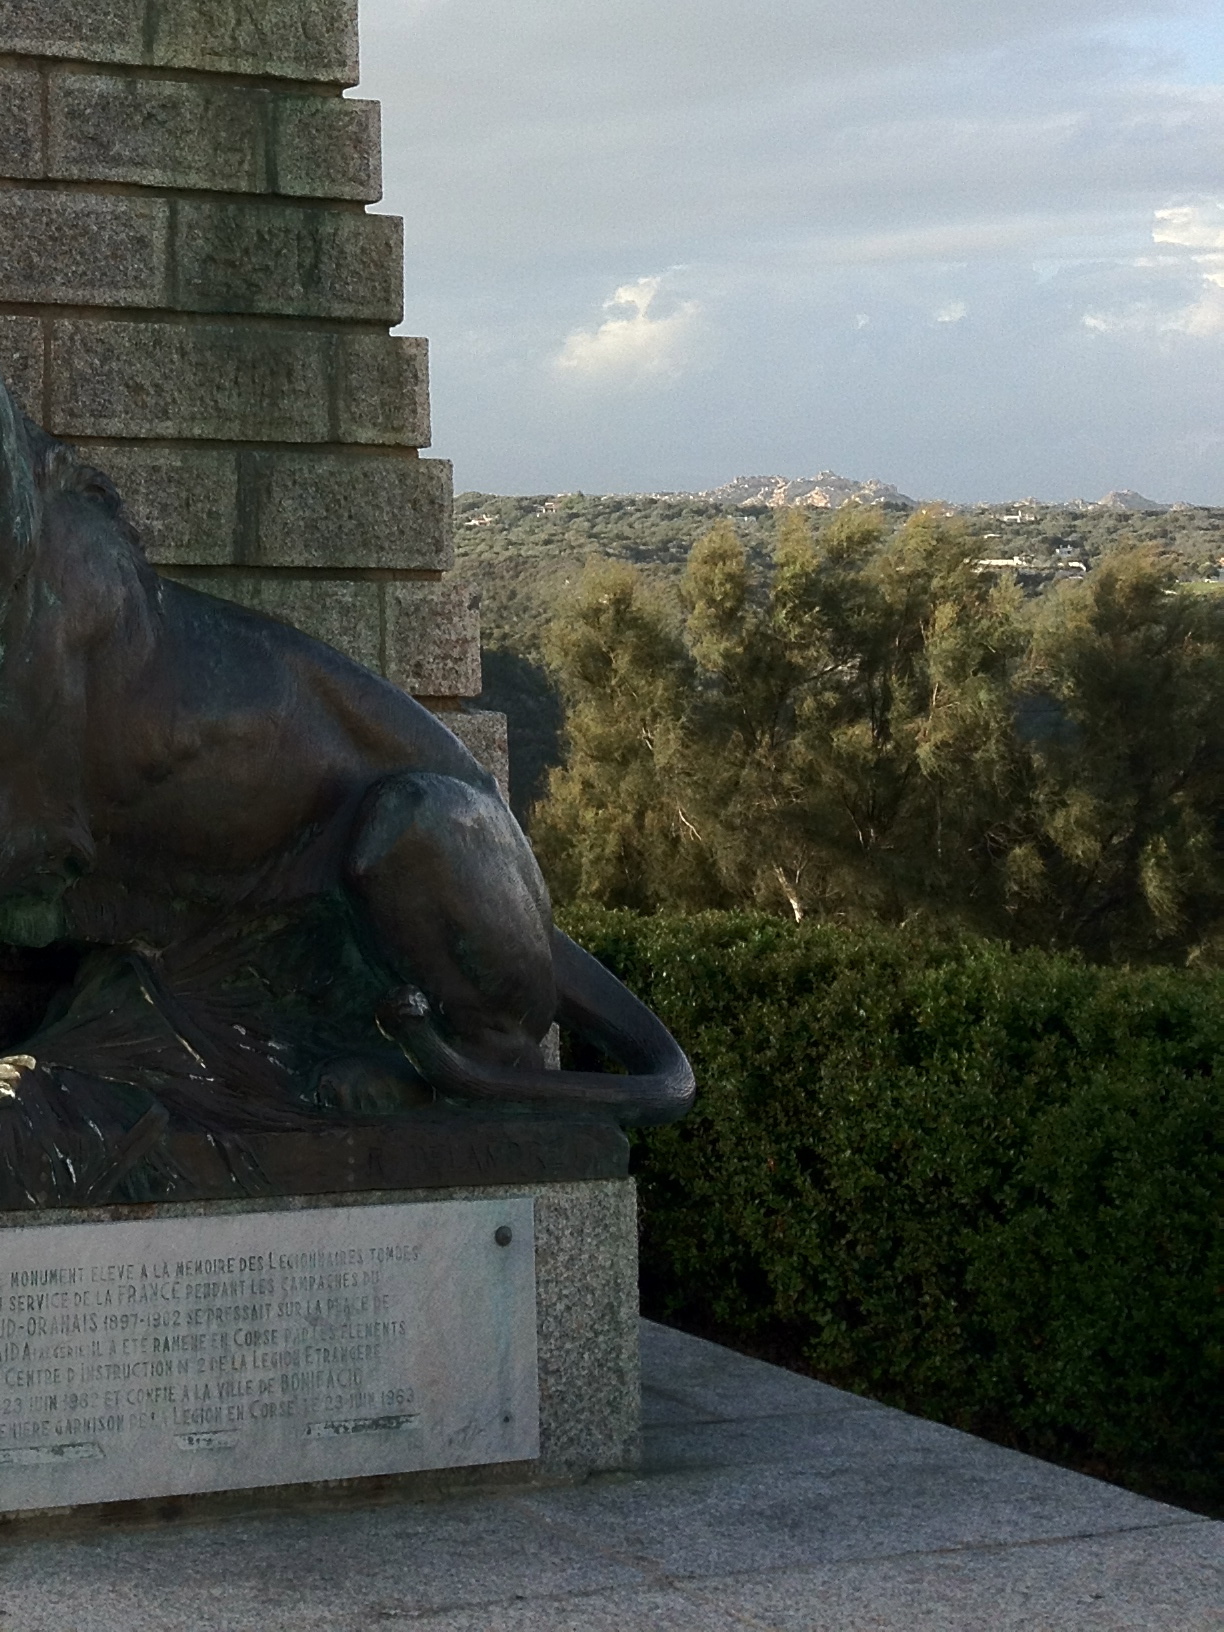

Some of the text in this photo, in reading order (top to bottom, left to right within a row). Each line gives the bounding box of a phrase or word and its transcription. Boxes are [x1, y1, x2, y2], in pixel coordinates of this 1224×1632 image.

[11, 1267, 83, 1287] MONUMENT
[91, 1264, 134, 1282] ELEVE
[140, 1263, 148, 1279] A
[153, 1261, 170, 1279] LA
[176, 1257, 235, 1279] MEMOIRE
[239, 1255, 264, 1273] DES
[268, 1248, 364, 1270] LEGIONNAIRES
[9, 1291, 68, 1312] SERVICE
[74, 1290, 90, 1307] DE
[96, 1289, 112, 1306] LA
[118, 1281, 180, 1305] FRANCE
[185, 1280, 246, 1299] PENDANT
[251, 1278, 274, 1295] LES
[281, 1270, 358, 1292] CAMPAGNES
[363, 1269, 380, 1286] DU
[103, 1309, 181, 1331] 1897-1902
[277, 1301, 302, 1318] SUR
[306, 1299, 322, 1315] LA
[327, 1296, 369, 1316] PLACE
[373, 1294, 389, 1311] DE
[109, 1339, 117, 1357] A
[123, 1336, 148, 1355] ETE
[153, 1333, 206, 1353] RAMENE
[211, 1332, 228, 1351] EN
[233, 1328, 278, 1348] CORSE
[284, 1327, 309, 1346] PAR
[341, 1320, 406, 1340] ELEMENTS
[5, 1366, 60, 1388] CENTRE
[210, 1355, 226, 1372] DE
[232, 1354, 247, 1371] LA
[253, 1349, 300, 1370] LEGION
[305, 1344, 381, 1365] ETRANGERE
[3, 1397, 22, 1415] 23
[29, 1394, 57, 1413] JUIN
[104, 1390, 120, 1409] ET
[126, 1386, 175, 1406] CONFIE
[182, 1385, 190, 1403] A
[195, 1383, 210, 1402] LA
[217, 1379, 252, 1400] VILLE
[259, 1377, 275, 1395] DE
[281, 1368, 362, 1394] BONIFACIO
[55, 1415, 124, 1436] GARNISON
[130, 1412, 147, 1430] DE
[173, 1406, 222, 1425] LEGION
[228, 1405, 244, 1422] EN
[250, 1400, 294, 1419] CORSE
[326, 1395, 343, 1412] 23
[350, 1392, 375, 1410] JUIN
[382, 1388, 414, 1407] 1963
